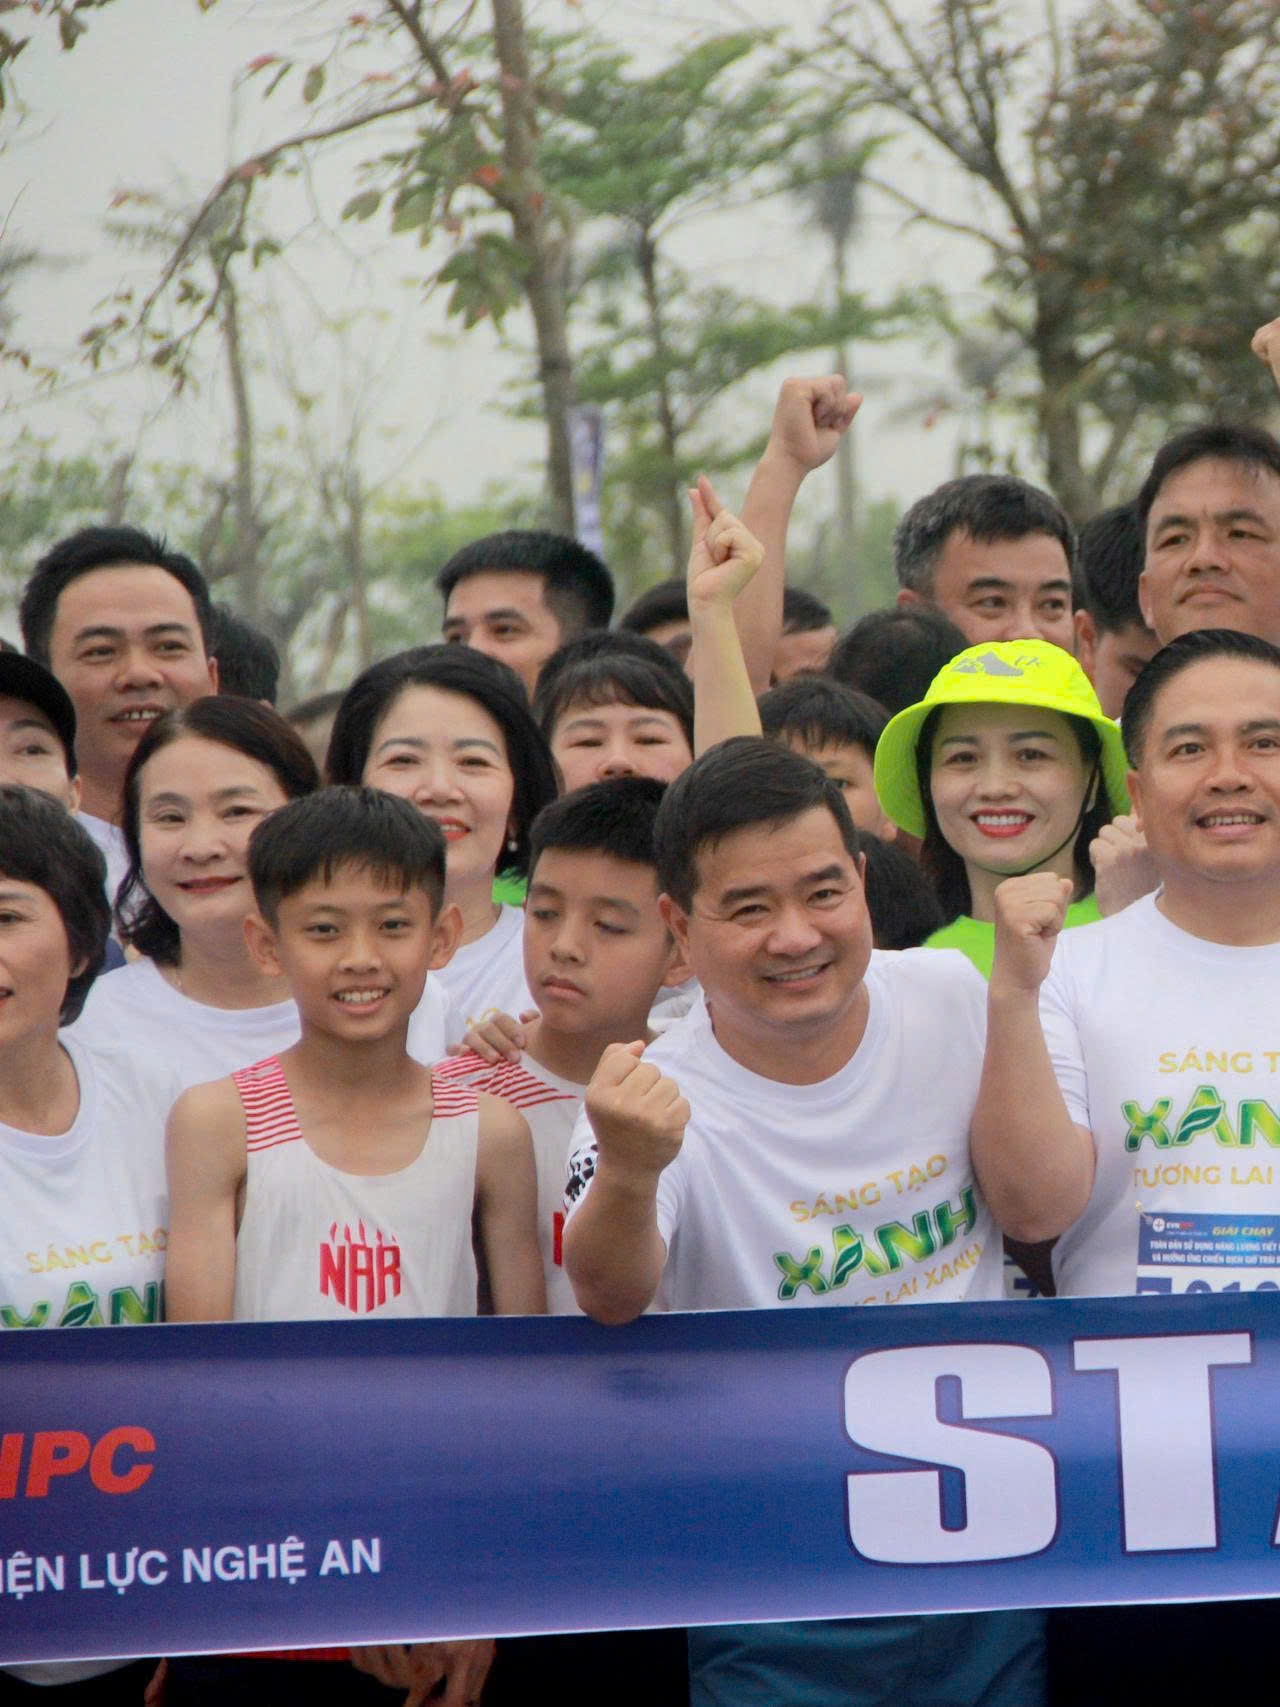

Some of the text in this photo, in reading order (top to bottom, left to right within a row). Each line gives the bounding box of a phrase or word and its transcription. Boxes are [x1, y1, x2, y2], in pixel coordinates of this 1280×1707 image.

[1158, 1047, 1254, 1074] SÁNG
[790, 1153, 947, 1223] SÁNG TẠO
[1134, 1163, 1221, 1188] TƯƠNG
[1230, 1166, 1273, 1186] LAI
[25, 1243, 112, 1274] SÁNG
[774, 1184, 978, 1300] XANH
[319, 1238, 401, 1313] NAR
[79, 1547, 169, 1595] LỰC
[182, 1536, 307, 1584] NGHỆ
[319, 1537, 381, 1576] AN
